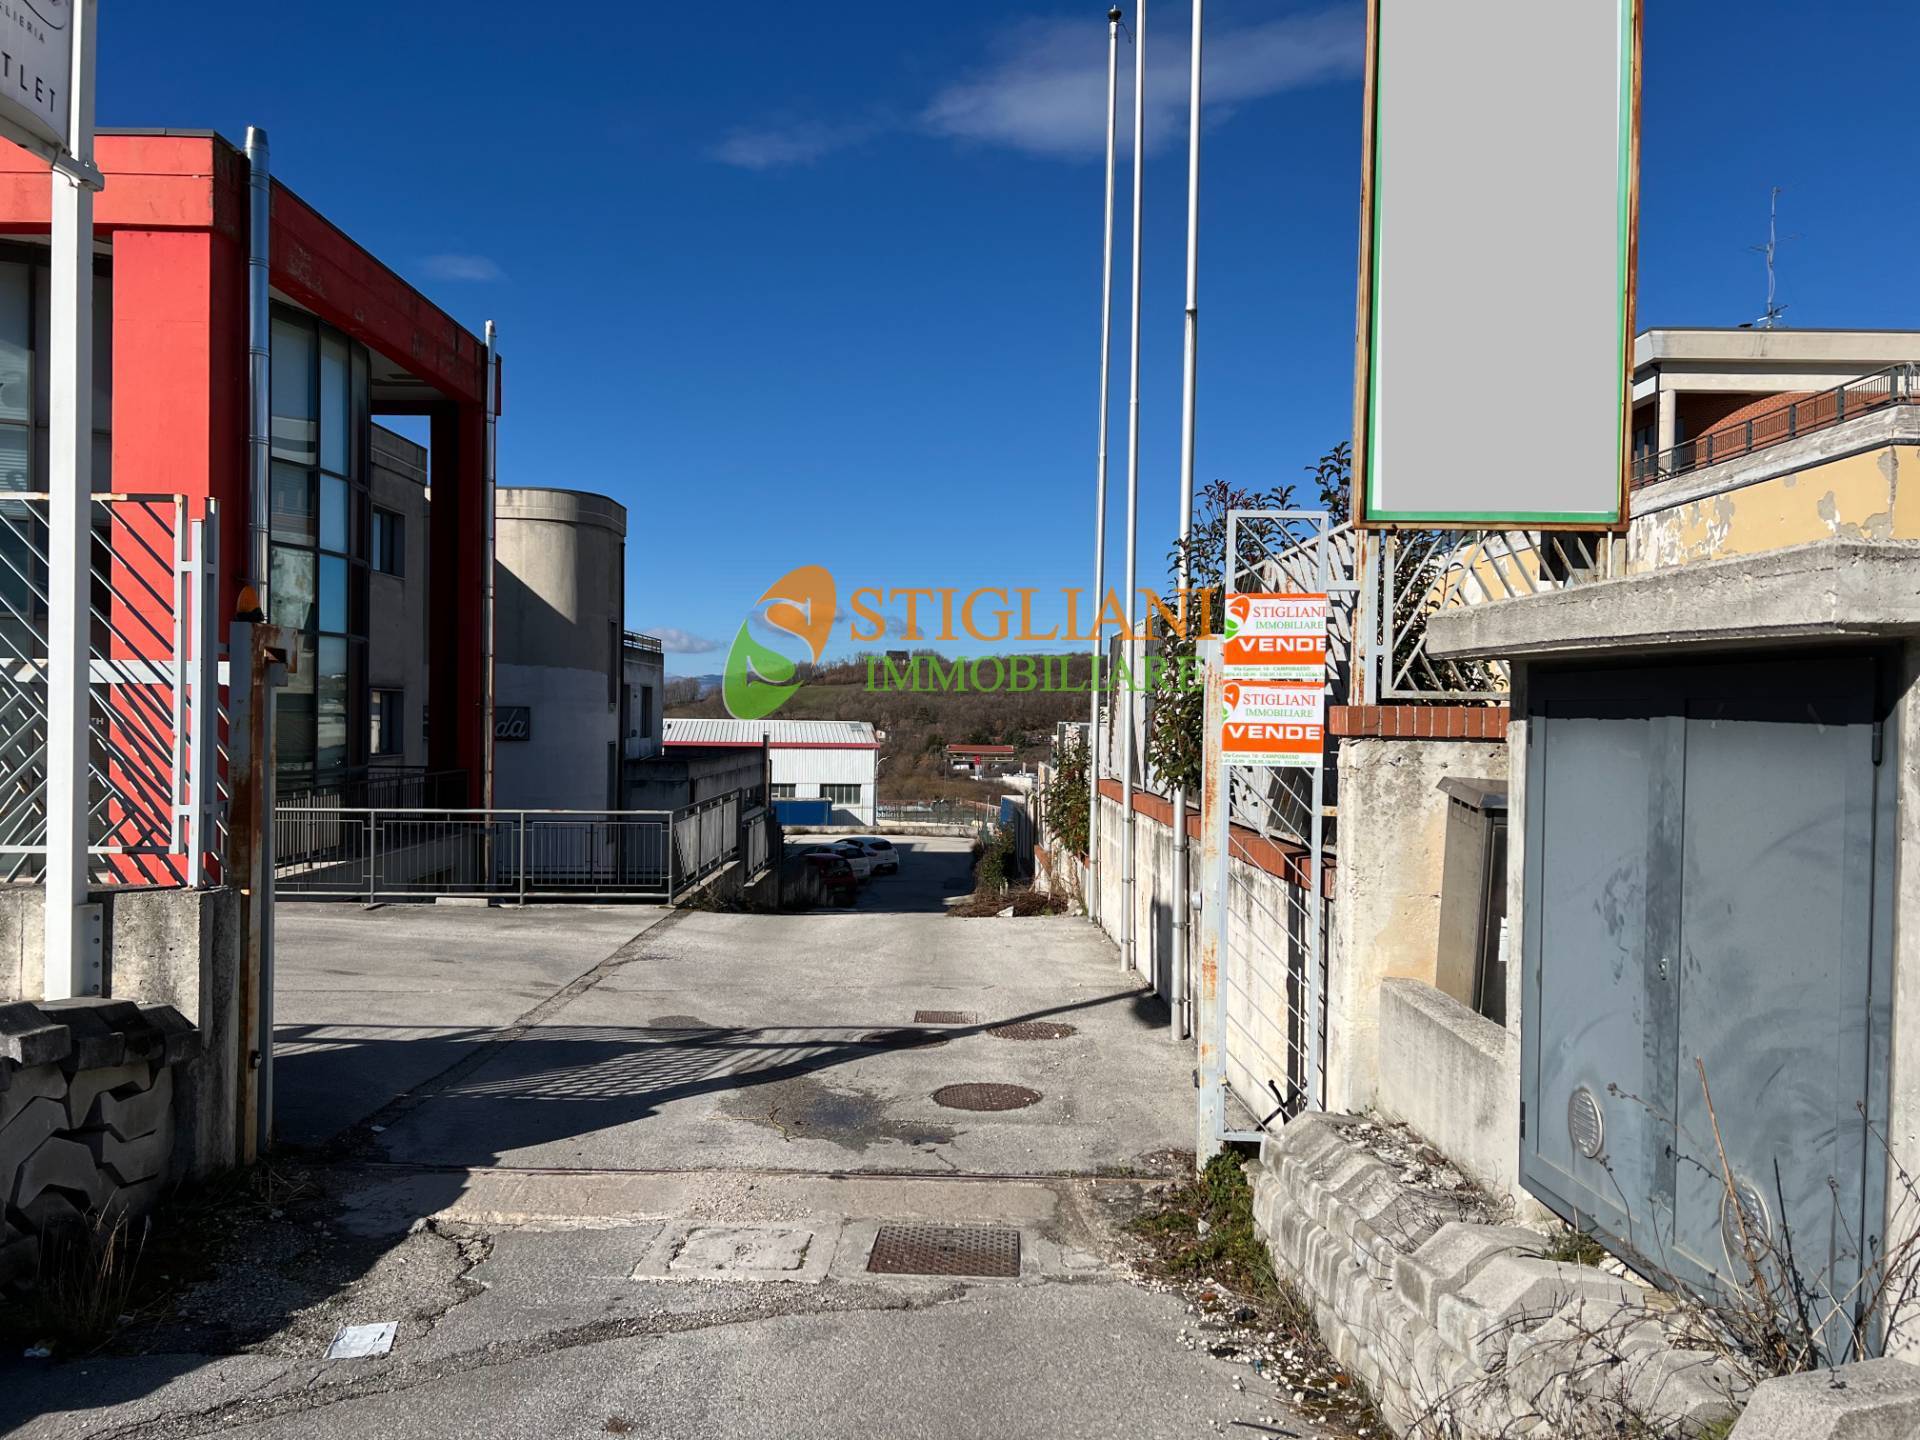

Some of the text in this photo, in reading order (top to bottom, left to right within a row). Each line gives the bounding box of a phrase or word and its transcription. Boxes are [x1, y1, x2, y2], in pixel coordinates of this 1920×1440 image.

[0, 3, 45, 44] LIERIA
[1253, 606, 1326, 618] STIGLIANI
[1256, 620, 1324, 629] IMMOBILIARE
[1238, 638, 1326, 652] VENDE
[1242, 693, 1317, 706] STIGLIANI
[1245, 708, 1314, 718] IMMOBILIARE
[1227, 725, 1321, 740] VENDE
